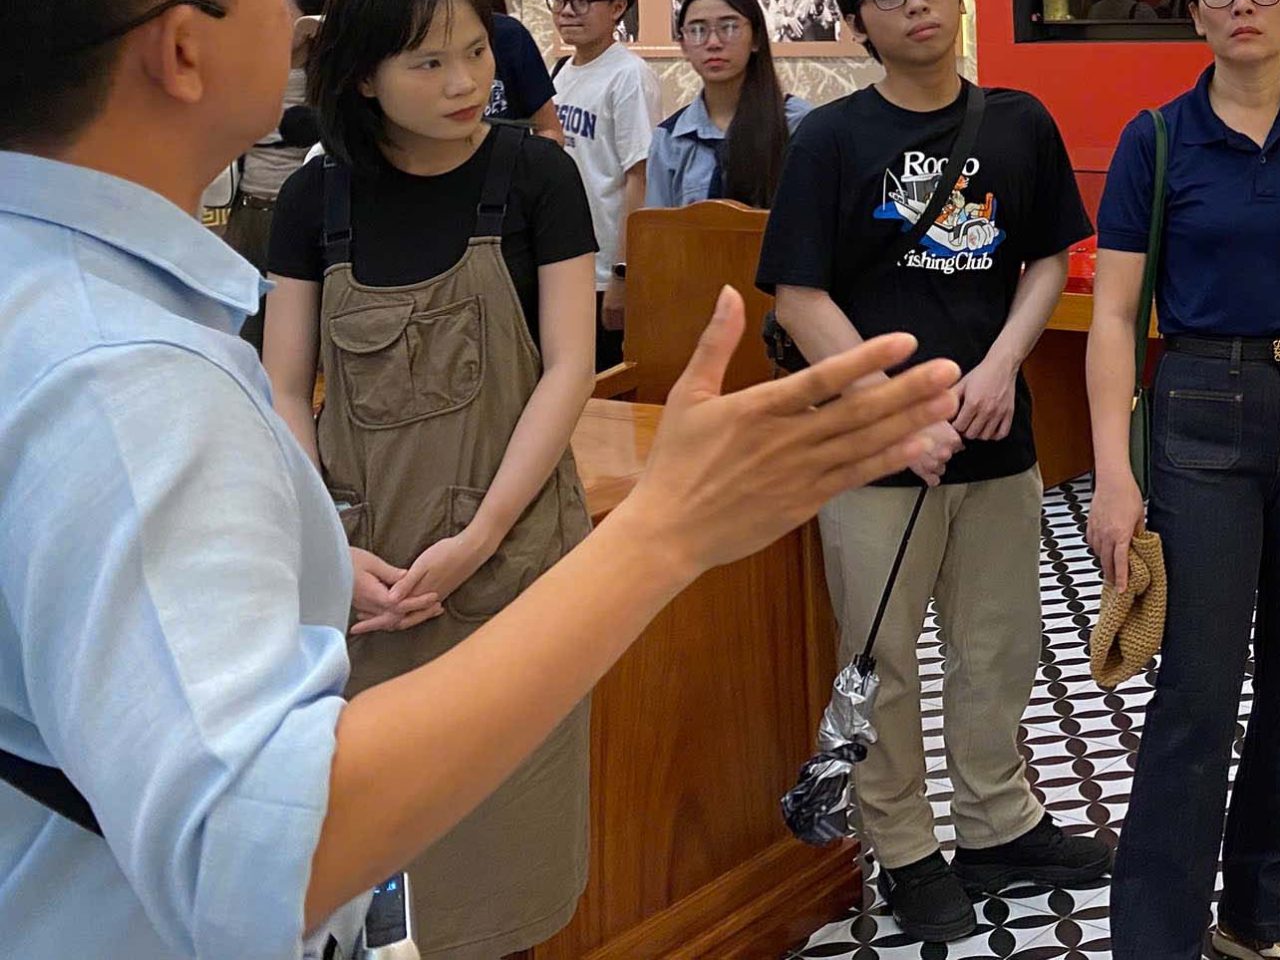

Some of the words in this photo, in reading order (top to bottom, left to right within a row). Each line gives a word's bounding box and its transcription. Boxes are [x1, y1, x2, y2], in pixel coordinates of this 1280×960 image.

[555, 105, 598, 140] SION
[903, 151, 980, 177] Roco
[898, 250, 955, 274] ishing
[956, 252, 993, 271] Club
